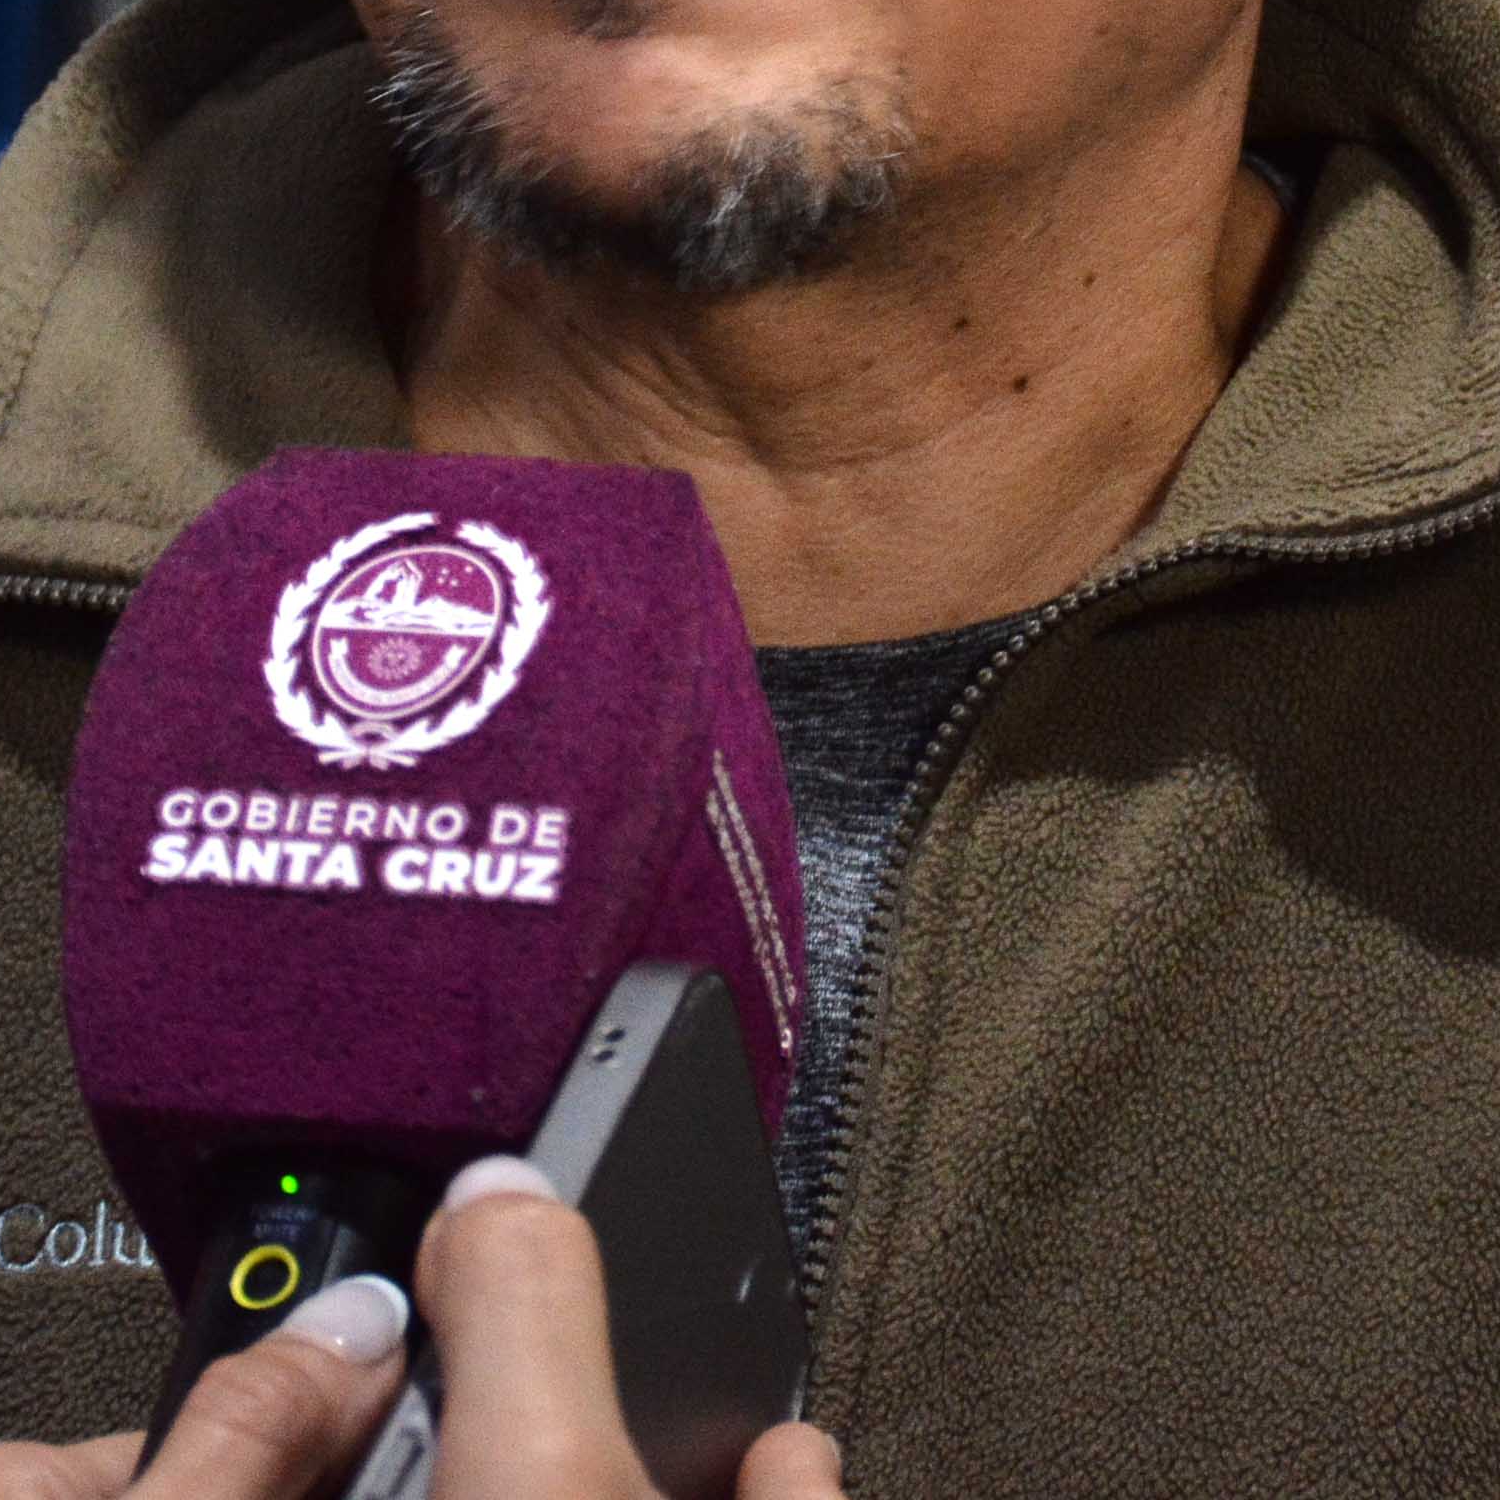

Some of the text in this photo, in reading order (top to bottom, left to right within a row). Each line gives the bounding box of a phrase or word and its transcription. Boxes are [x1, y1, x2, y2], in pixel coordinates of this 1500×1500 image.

[159, 790, 566, 850] GOBIERNO DE
[146, 834, 560, 900] SANTA CRUZ
